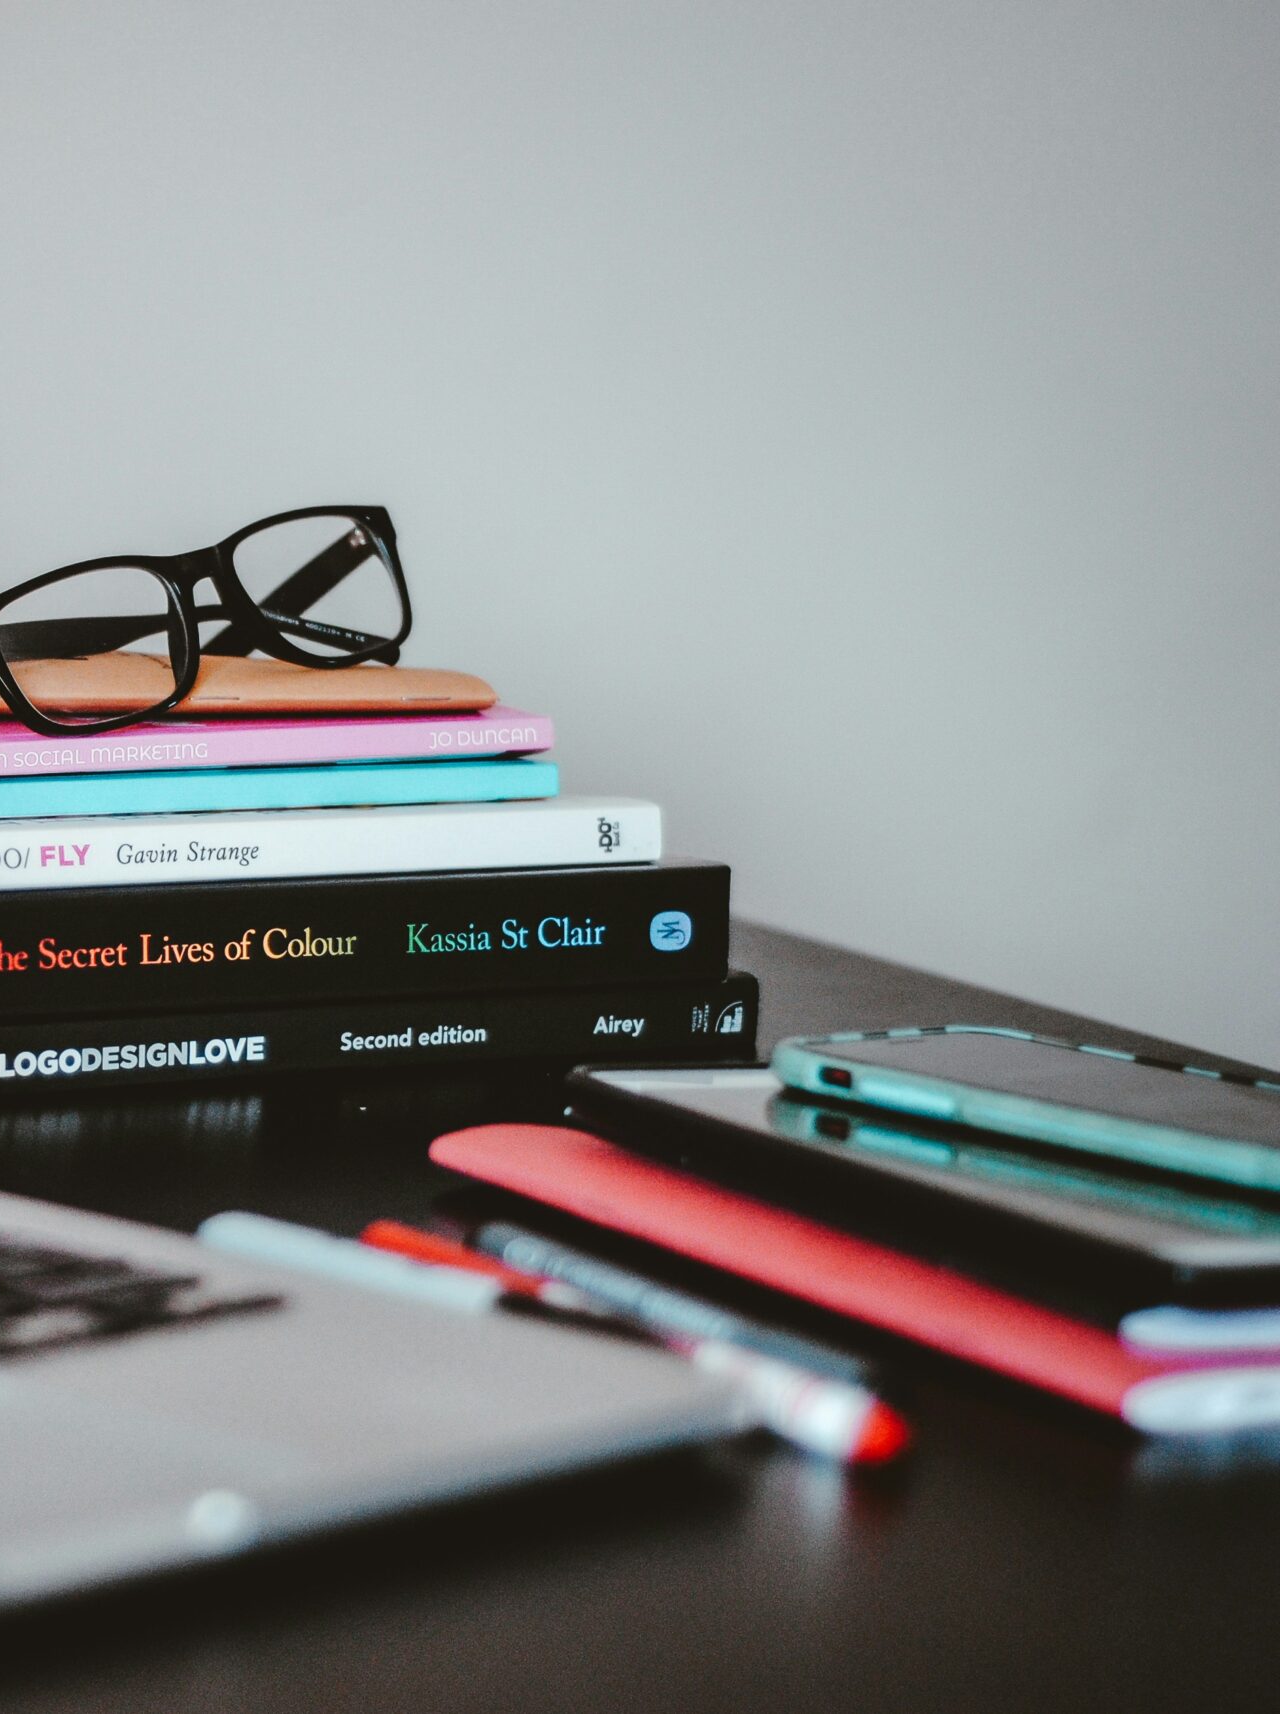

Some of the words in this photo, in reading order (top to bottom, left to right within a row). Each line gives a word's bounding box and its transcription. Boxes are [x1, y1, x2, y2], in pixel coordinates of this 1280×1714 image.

[428, 731, 453, 750] JO
[457, 727, 538, 747] DUNCAN
[13, 749, 86, 768] SOCIAL
[90, 742, 208, 764] MARKETING
[39, 844, 91, 868] FLY
[116, 843, 178, 865] Gavin
[186, 840, 260, 867] Strange
[38, 937, 128, 970] Secret
[139, 933, 215, 965] Lives
[224, 928, 257, 961] of
[262, 926, 357, 960] Colour
[406, 923, 492, 954] Kassia
[501, 918, 529, 950] St
[537, 916, 606, 948] Clair
[340, 1027, 412, 1052] Second
[418, 1024, 487, 1047] edition
[593, 1014, 645, 1038] Airey
